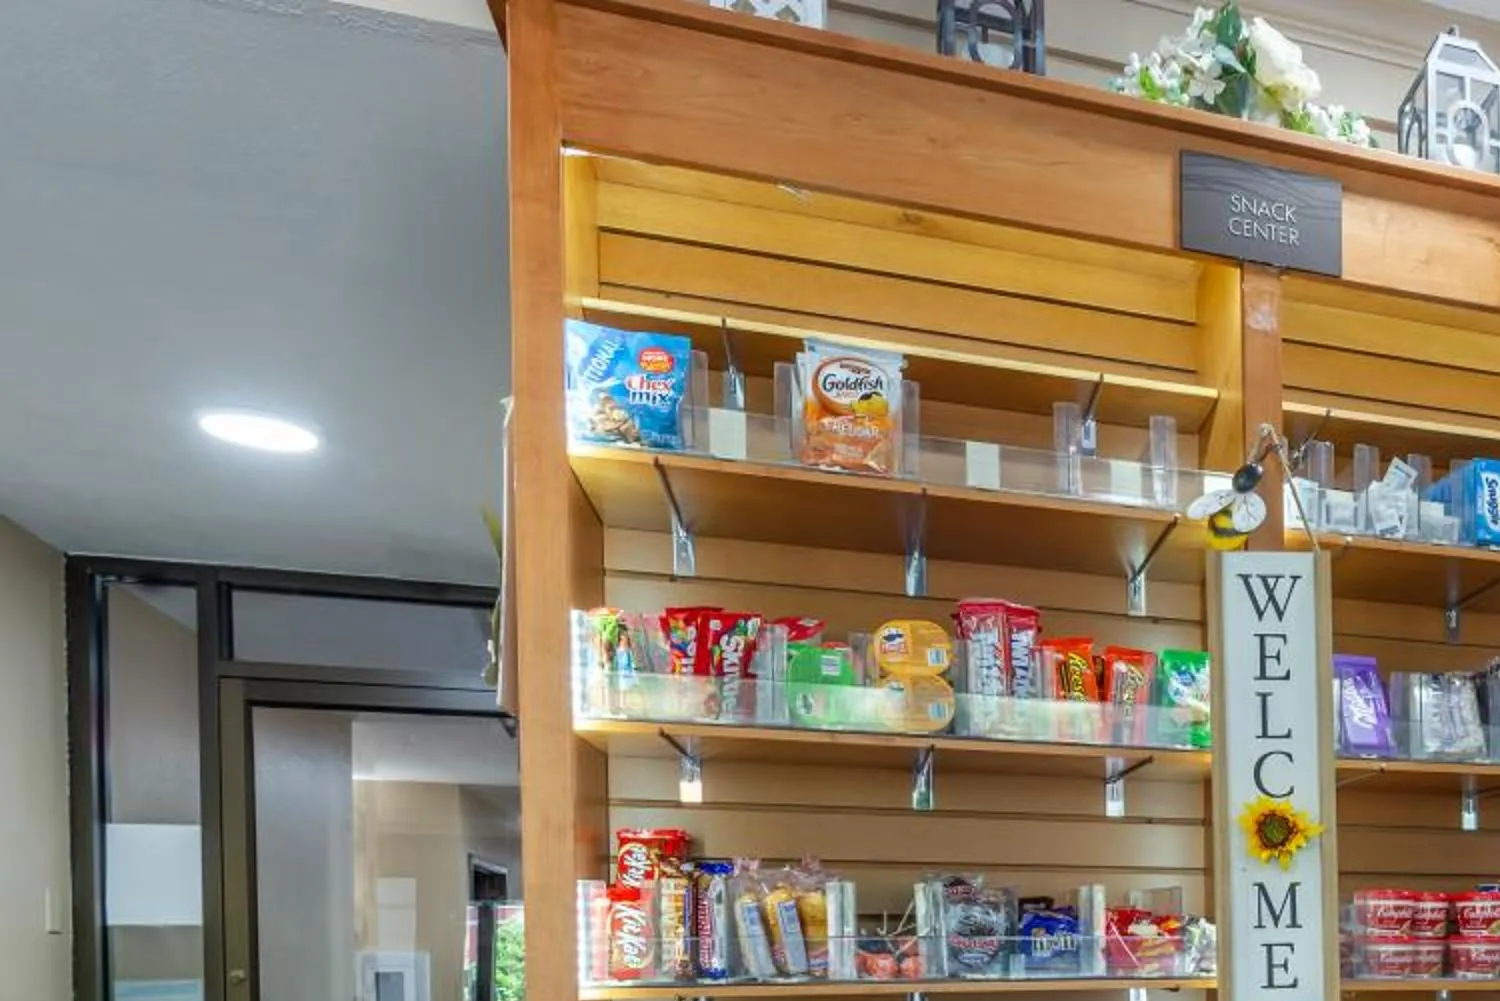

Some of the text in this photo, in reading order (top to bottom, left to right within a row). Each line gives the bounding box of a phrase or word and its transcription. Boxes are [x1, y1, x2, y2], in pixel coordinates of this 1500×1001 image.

[1230, 193, 1297, 223] SNACK
[1228, 217, 1300, 247] CENTER
[624, 374, 675, 392] Chex
[629, 390, 670, 405] mix
[823, 373, 884, 393] Goldfish
[1484, 475, 1500, 528] Snuggle
[1236, 573, 1303, 989] WELCME
